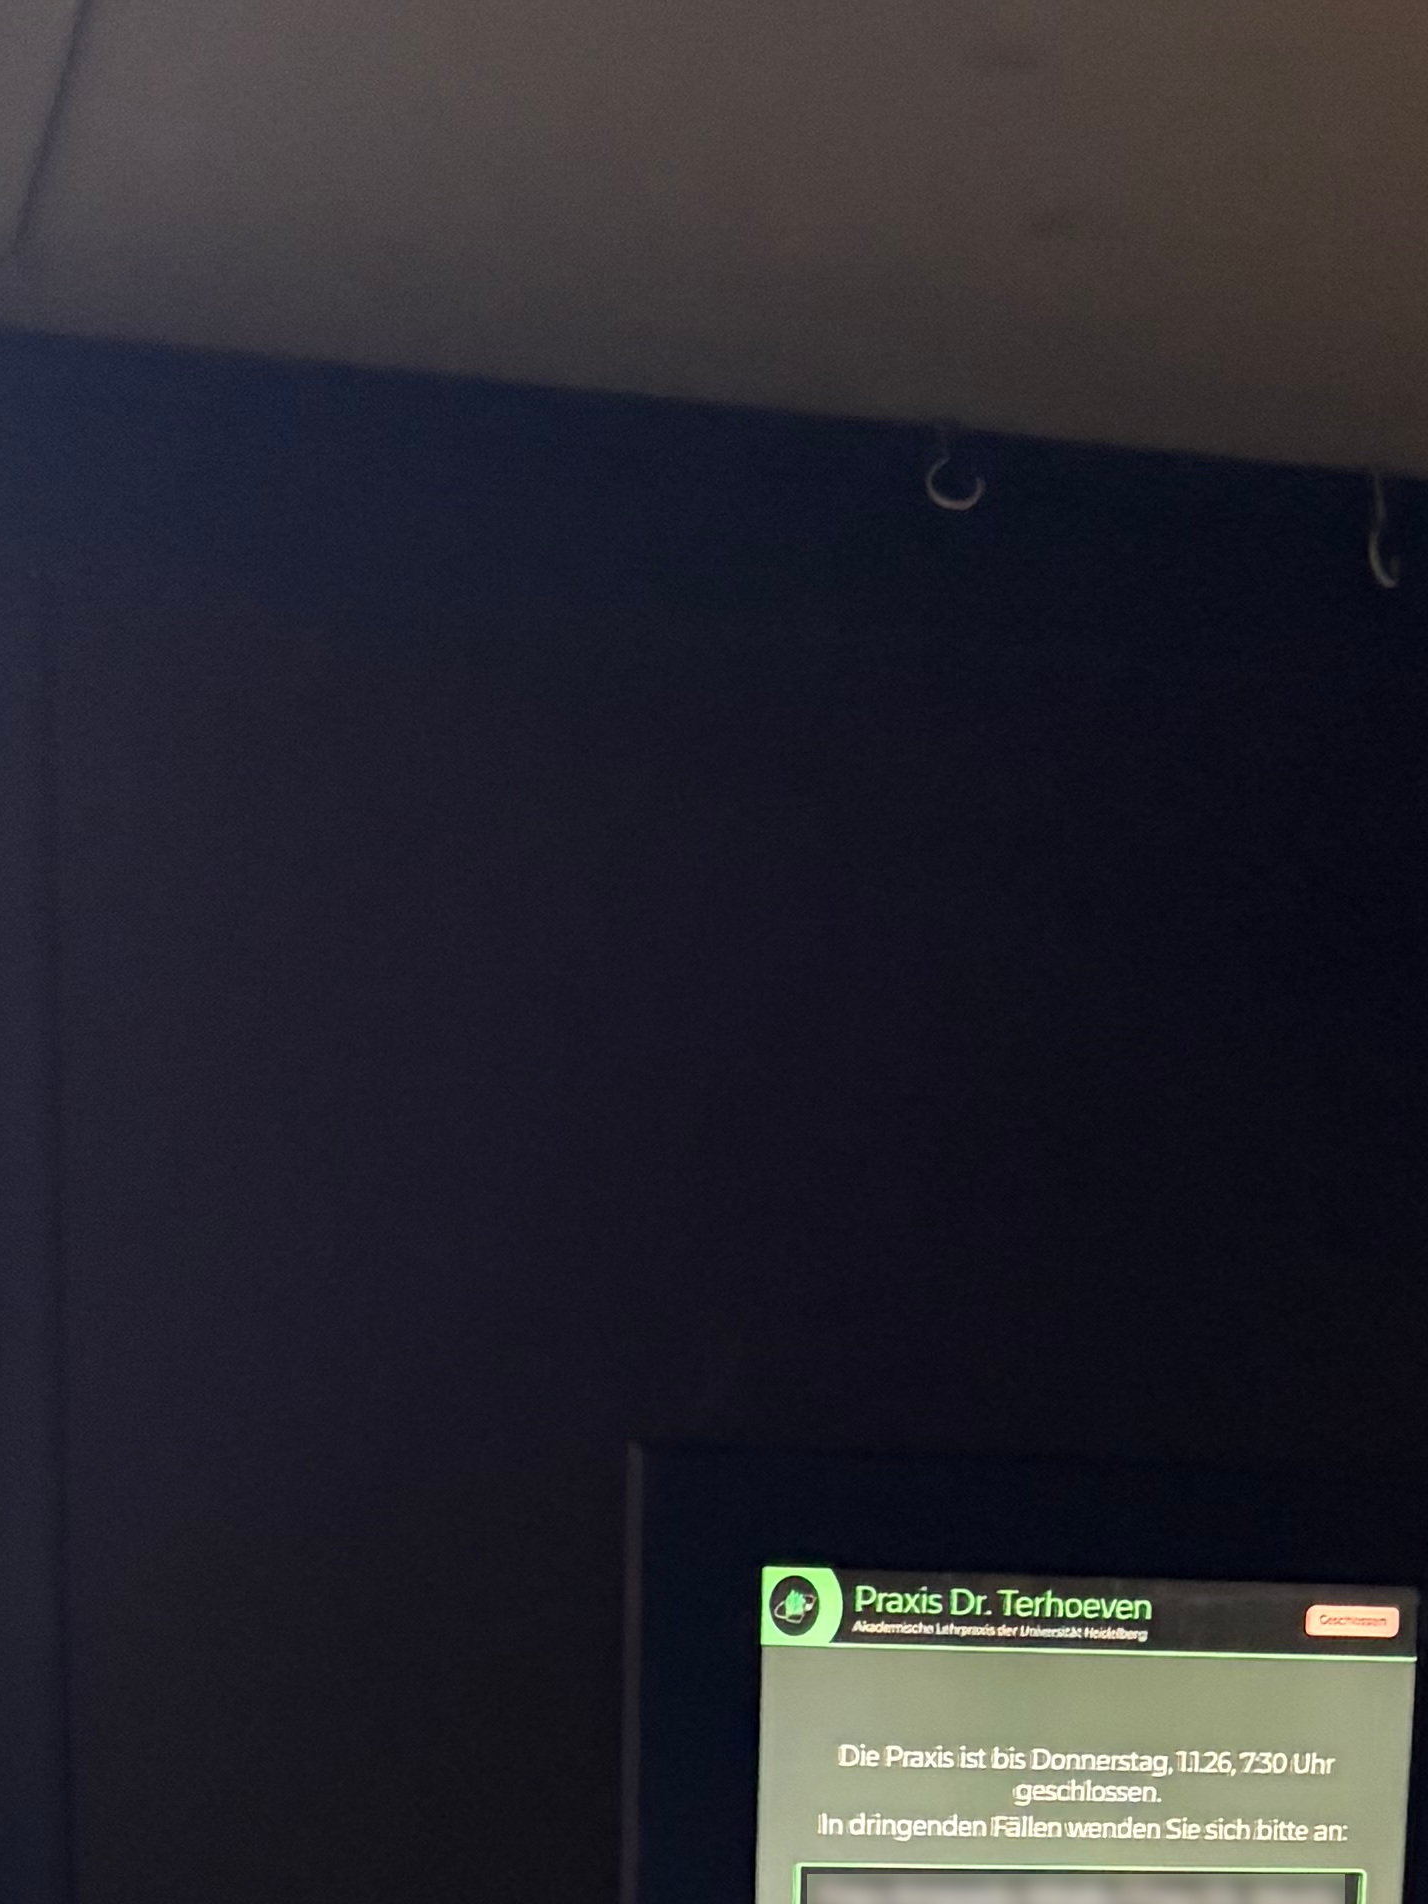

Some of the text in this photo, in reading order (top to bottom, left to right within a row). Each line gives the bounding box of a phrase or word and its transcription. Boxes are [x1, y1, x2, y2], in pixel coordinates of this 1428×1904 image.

[854, 1584, 1152, 1621] Praxis Dr. Terhoeven
[851, 1620, 935, 1636] Akademische
[997, 1624, 1018, 1637] der
[837, 1743, 880, 1768] Die
[884, 1745, 954, 1769] Praxis
[958, 1745, 987, 1770] ist
[990, 1746, 1027, 1771] bis
[1030, 1748, 1174, 1778] Donnerstag,
[1290, 1752, 1336, 1775] Uhr
[1013, 1779, 1162, 1806] geschlossen.
[817, 1813, 1348, 1842] In dringenden Fällen wenden Sie sich bitte an:
